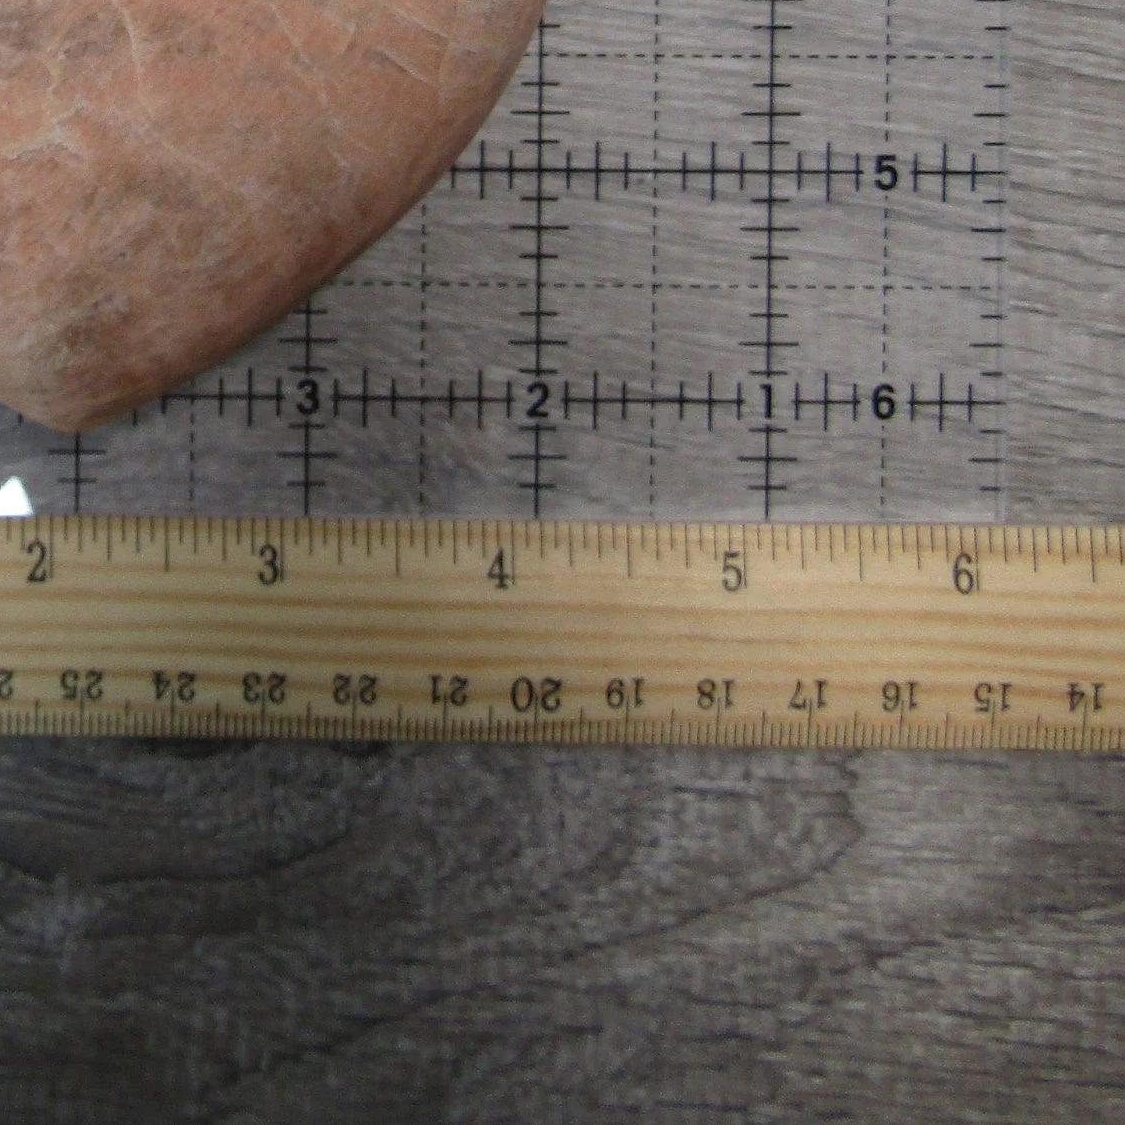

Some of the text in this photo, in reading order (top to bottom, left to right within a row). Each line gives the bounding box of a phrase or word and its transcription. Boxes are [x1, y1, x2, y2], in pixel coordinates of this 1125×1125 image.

[875, 155, 898, 191] 5
[296, 379, 320, 415] 3
[527, 382, 550, 417] 2
[759, 383, 772, 419] 1
[872, 384, 895, 420] 6
[27, 539, 48, 583] 2
[257, 544, 279, 585] 3
[487, 547, 510, 590] 4
[722, 550, 743, 592] 5
[953, 553, 975, 594] 6
[60, 668, 103, 701] 25
[152, 670, 196, 701] 24
[242, 671, 286, 704] 23
[333, 673, 377, 705] 22
[430, 674, 468, 706] 21
[510, 677, 563, 712] 20
[606, 677, 645, 709] 19
[696, 678, 734, 710] 18
[788, 679, 828, 710] 17
[882, 680, 918, 711] 16
[975, 682, 1011, 712] 15
[1068, 682, 1104, 712] 14
